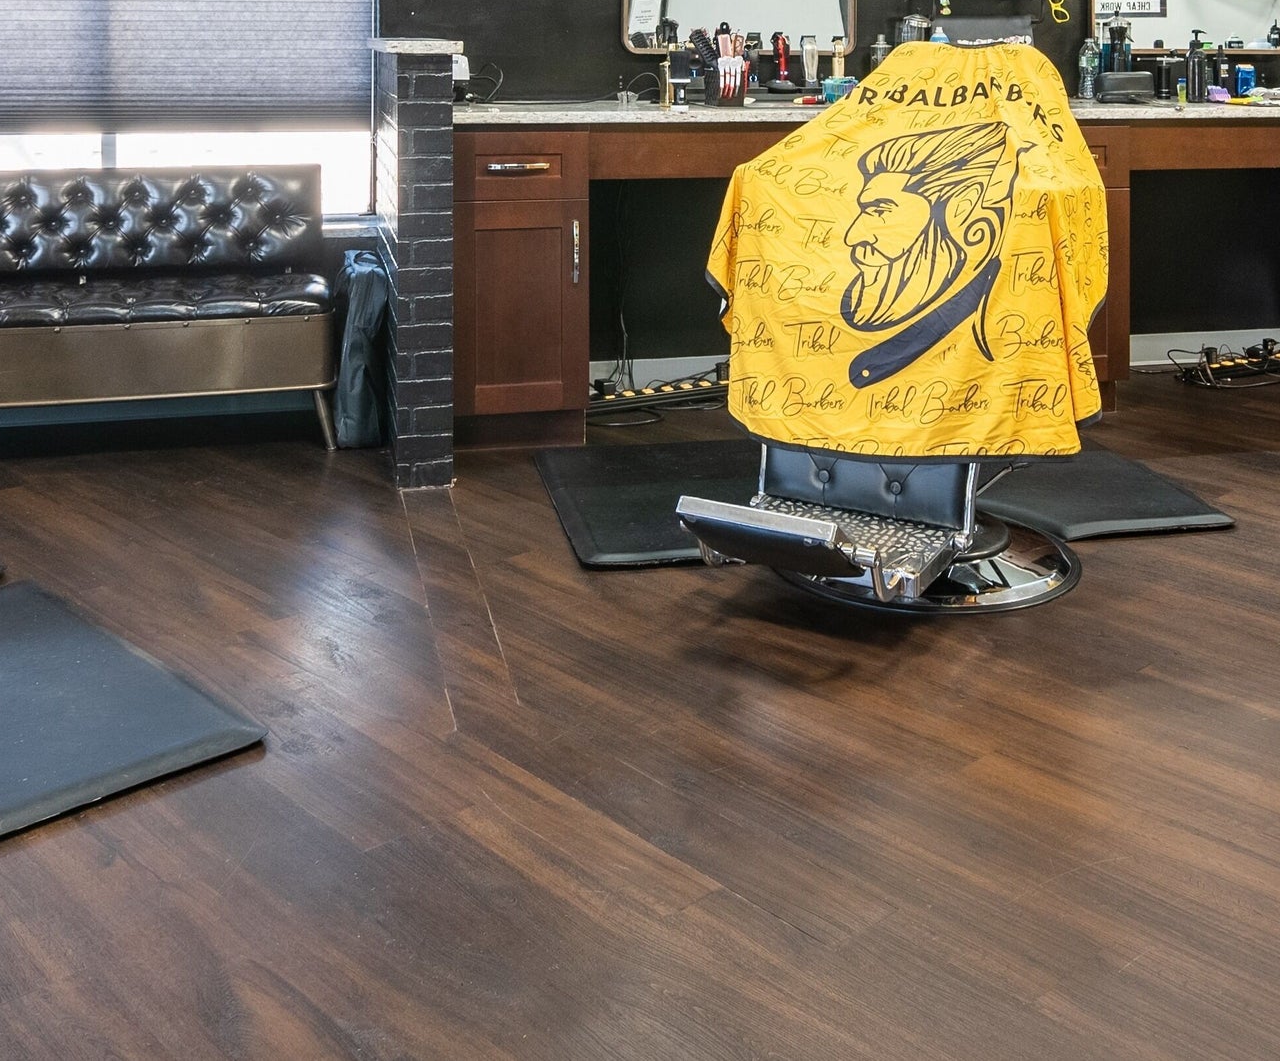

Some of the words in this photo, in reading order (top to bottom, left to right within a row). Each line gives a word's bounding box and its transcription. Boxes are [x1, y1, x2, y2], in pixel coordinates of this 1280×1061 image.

[736, 259, 773, 294] Tribal
[1011, 251, 1057, 292] Tribal
[784, 321, 840, 357] Tribal
[782, 377, 844, 416] Barbers
[921, 381, 989, 424] Barbers
[1004, 379, 1068, 419] Tribal
